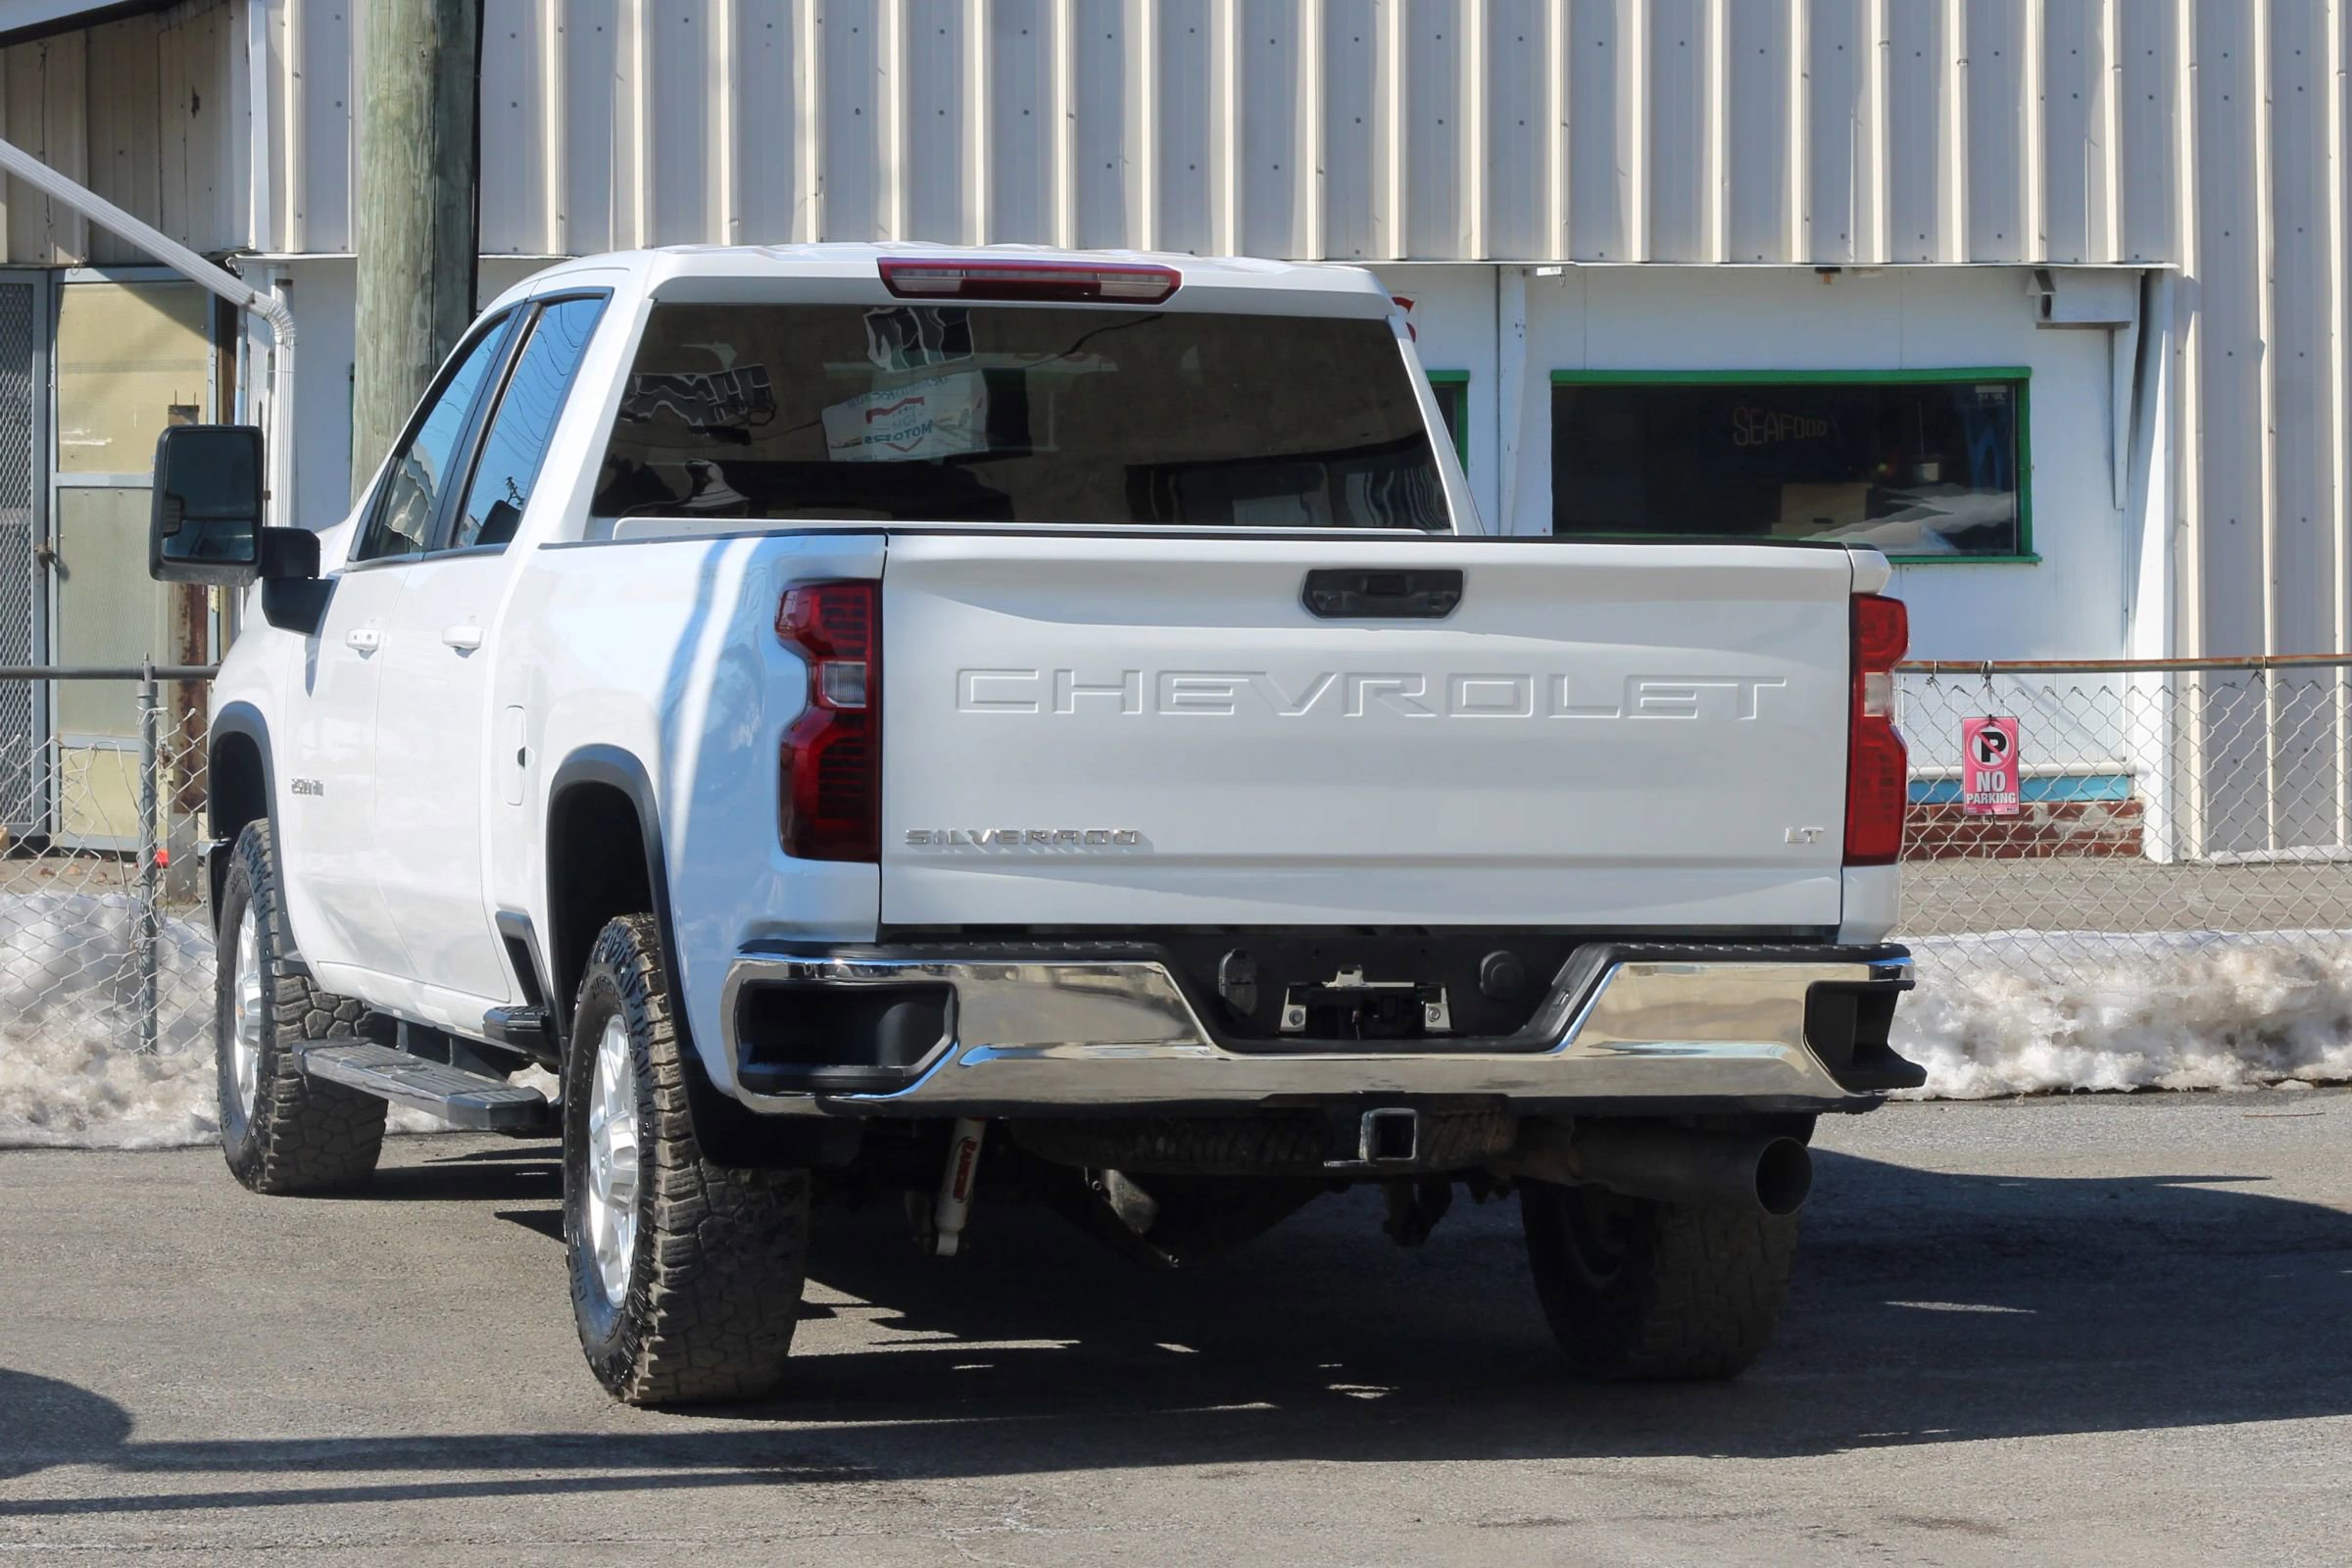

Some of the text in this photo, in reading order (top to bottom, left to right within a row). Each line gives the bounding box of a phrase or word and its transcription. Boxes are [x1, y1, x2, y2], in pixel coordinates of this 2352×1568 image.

[1733, 406, 1828, 447] SEAFOOD
[956, 667, 1787, 720] CHEVROLET
[1976, 770, 2007, 793] NO
[1966, 792, 2016, 805] PARKING
[905, 827, 1142, 846] SILVERADO
[1785, 826, 1825, 844] LT
